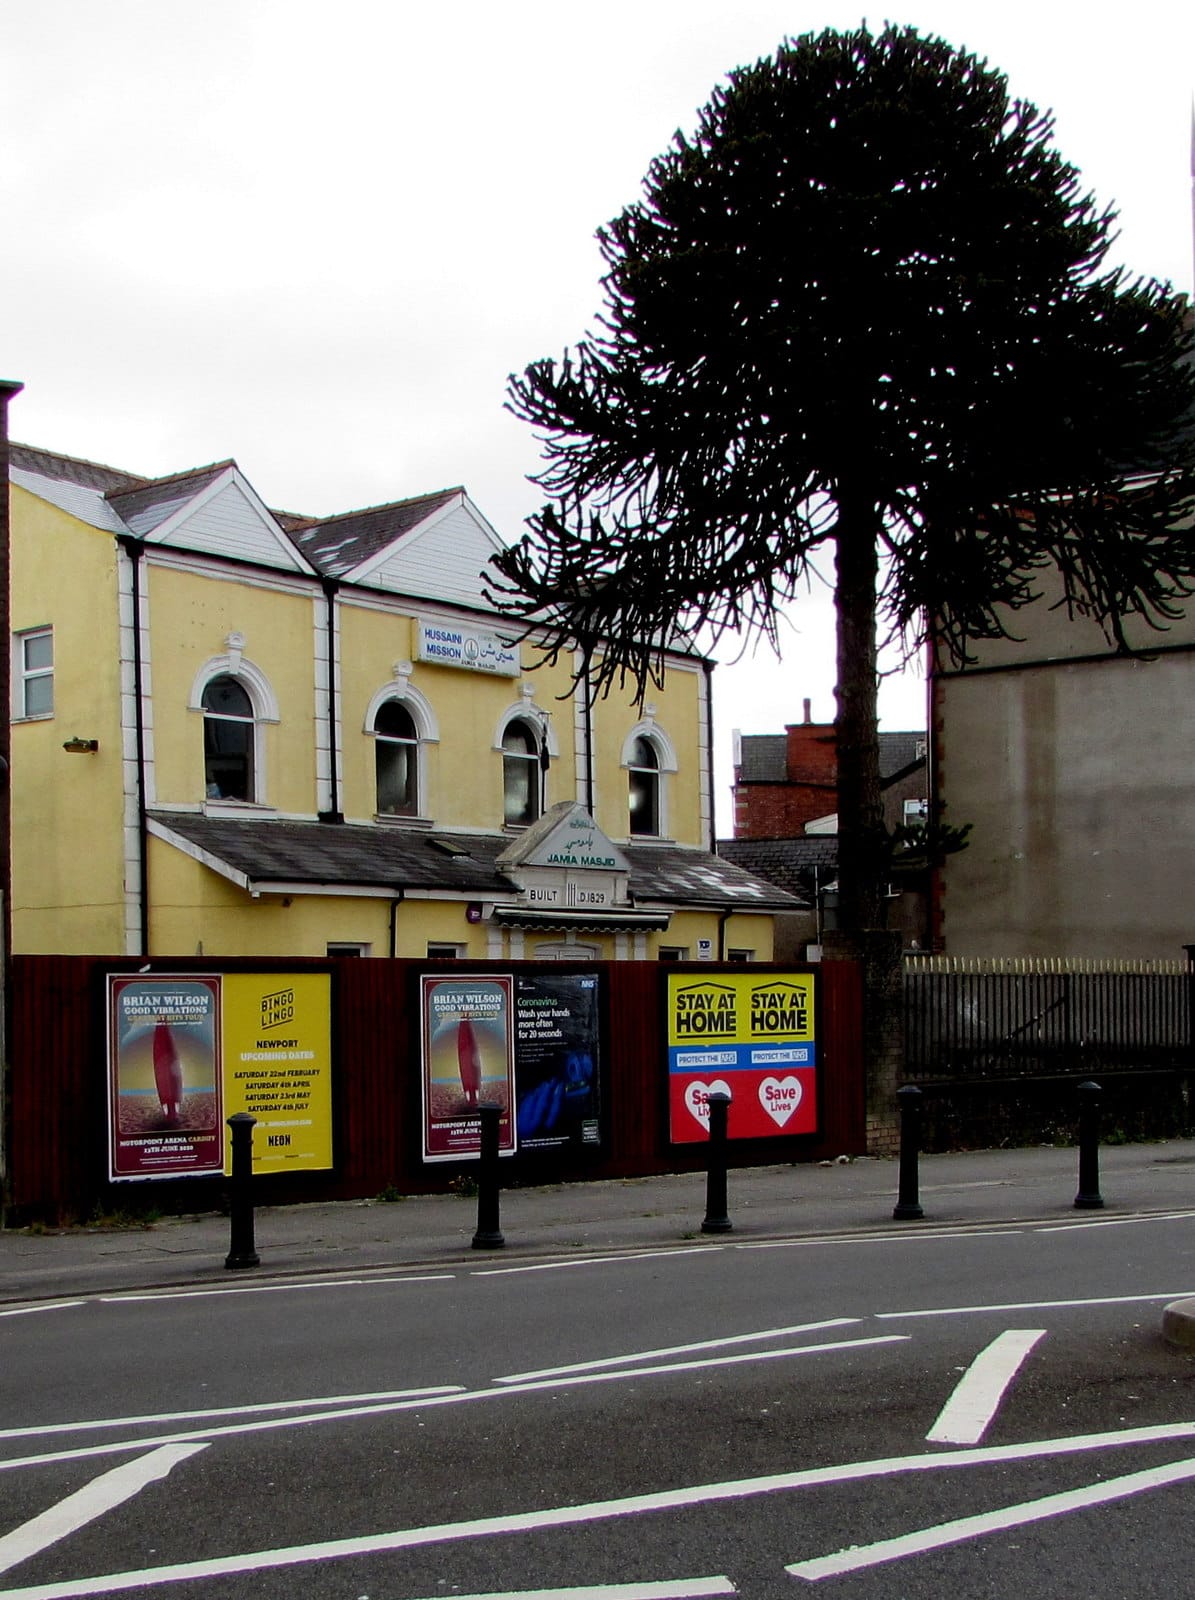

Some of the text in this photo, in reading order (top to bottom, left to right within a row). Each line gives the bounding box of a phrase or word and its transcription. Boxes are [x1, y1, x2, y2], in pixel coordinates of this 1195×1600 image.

[425, 628, 462, 644] HUSSAINI
[427, 644, 461, 659] MISSION
[547, 854, 615, 867] JAMIA MASJID
[530, 890, 557, 901] BUILT
[580, 980, 595, 989] NHS
[123, 995, 208, 1006] BRIAN WILSON
[261, 992, 294, 1012] BINGO
[433, 994, 502, 1004] BRIAN WILSON
[517, 996, 558, 1007] Coronavirus
[677, 994, 736, 1011] STAY AT
[751, 993, 807, 1009] STAY AT
[124, 1006, 207, 1014] GOOD VIBRATIONS
[457, 1003, 501, 1011] VIBRATIONS
[261, 1006, 294, 1027] LINGO
[517, 1008, 570, 1020] Wash your hands
[518, 1018, 554, 1029] more often
[677, 1011, 736, 1032] HOME
[751, 1009, 807, 1031] HOME
[518, 1028, 562, 1039] for 20 seconds
[256, 1040, 298, 1049] NEWPORT
[240, 1050, 314, 1061] UPCOMING DATES
[679, 1053, 735, 1064] PROTECT THE NHS
[753, 1050, 807, 1062] PROTECT THE NHS
[234, 1069, 321, 1079] SATURDAY 22nd FEBRUARY
[245, 1082, 279, 1090] SATURDAY
[292, 1080, 311, 1088] APRIL
[245, 1093, 279, 1101] SATURDAY
[296, 1091, 311, 1099] MAY
[765, 1085, 796, 1101] Save
[248, 1104, 281, 1112] SATURDAY
[294, 1103, 309, 1111] JULY
[770, 1101, 792, 1112] Lives
[120, 1138, 163, 1147] MOTORPOINT
[188, 1135, 216, 1143] CARDIFF
[268, 1134, 291, 1147] NEON
